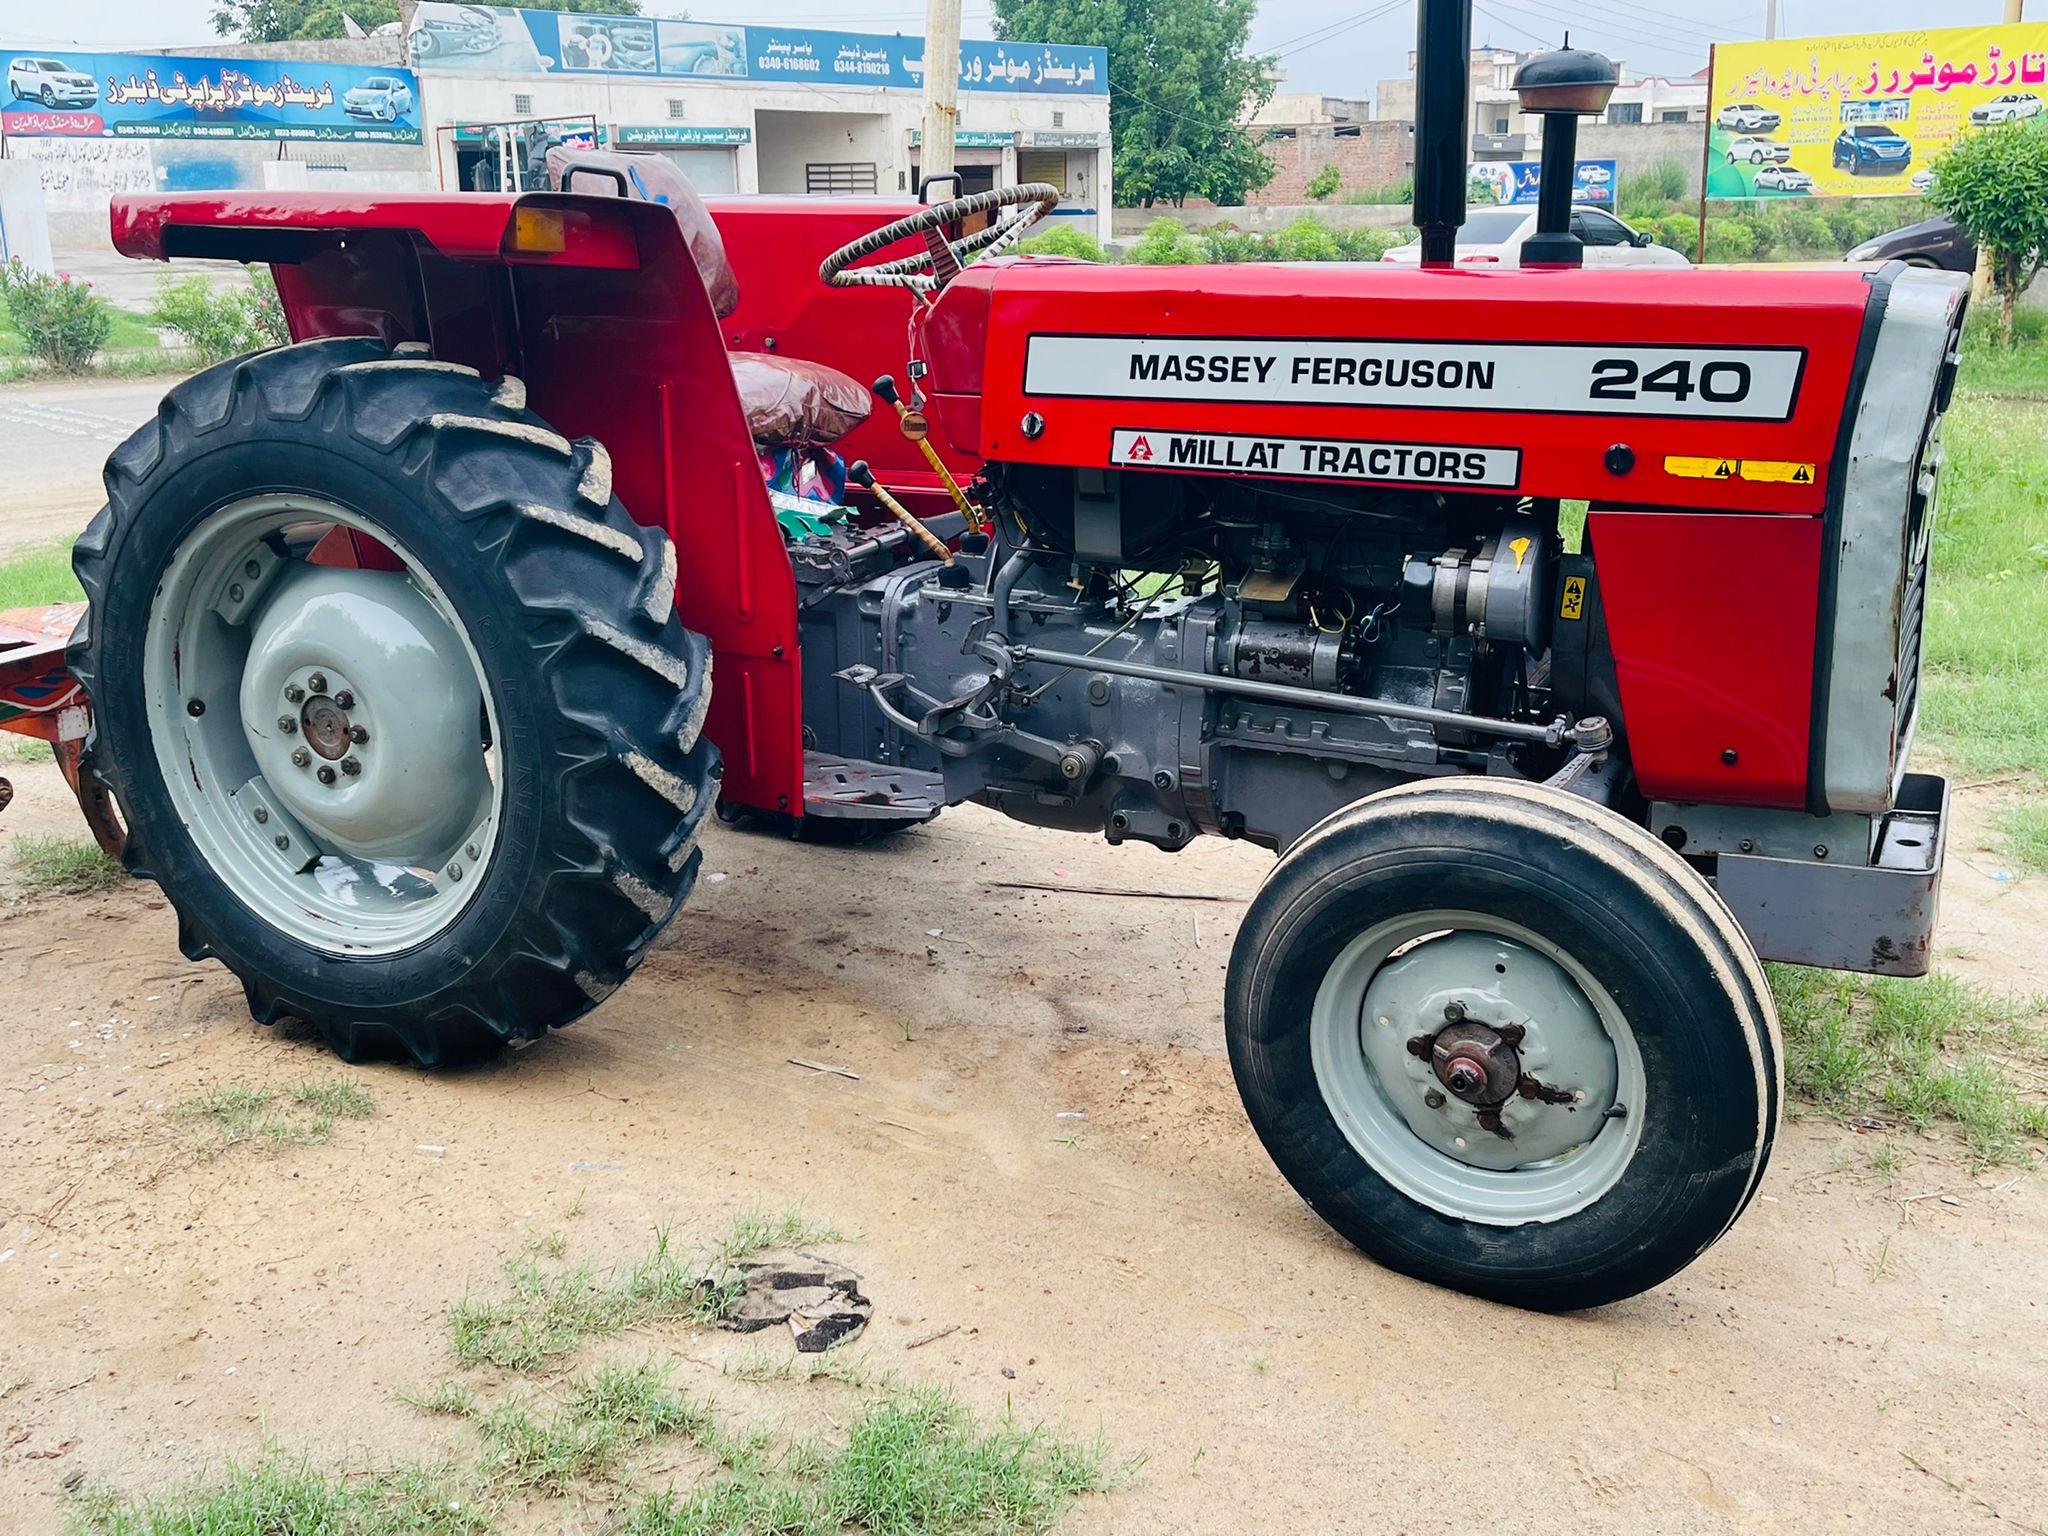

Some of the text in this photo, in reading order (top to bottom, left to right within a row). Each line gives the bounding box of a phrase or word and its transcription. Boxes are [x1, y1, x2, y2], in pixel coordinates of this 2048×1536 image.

[758, 56, 820, 72] 0340-6168602
[766, 38, 812, 56] یاسر پینٹر
[837, 44, 888, 62] یاسین ڈینٹر
[834, 60, 890, 76] 0344-8190218
[985, 48, 1031, 84] موٹر
[1034, 48, 1096, 86] فرینڈز
[1980, 46, 2046, 86] تارڑ
[106, 68, 160, 106] ڈیلرز
[160, 72, 226, 112] پراپرٹی
[224, 74, 277, 108] موٹرز
[274, 74, 334, 110] فرینڈز
[626, 128, 662, 142] ڈیکوریشن
[664, 128, 679, 142] اینڈ
[724, 128, 748, 142] فرینڈز
[1130, 355, 1751, 403] MASSEY FERGUSON 240
[1169, 437, 1486, 480] MILLAT TRACTORS
